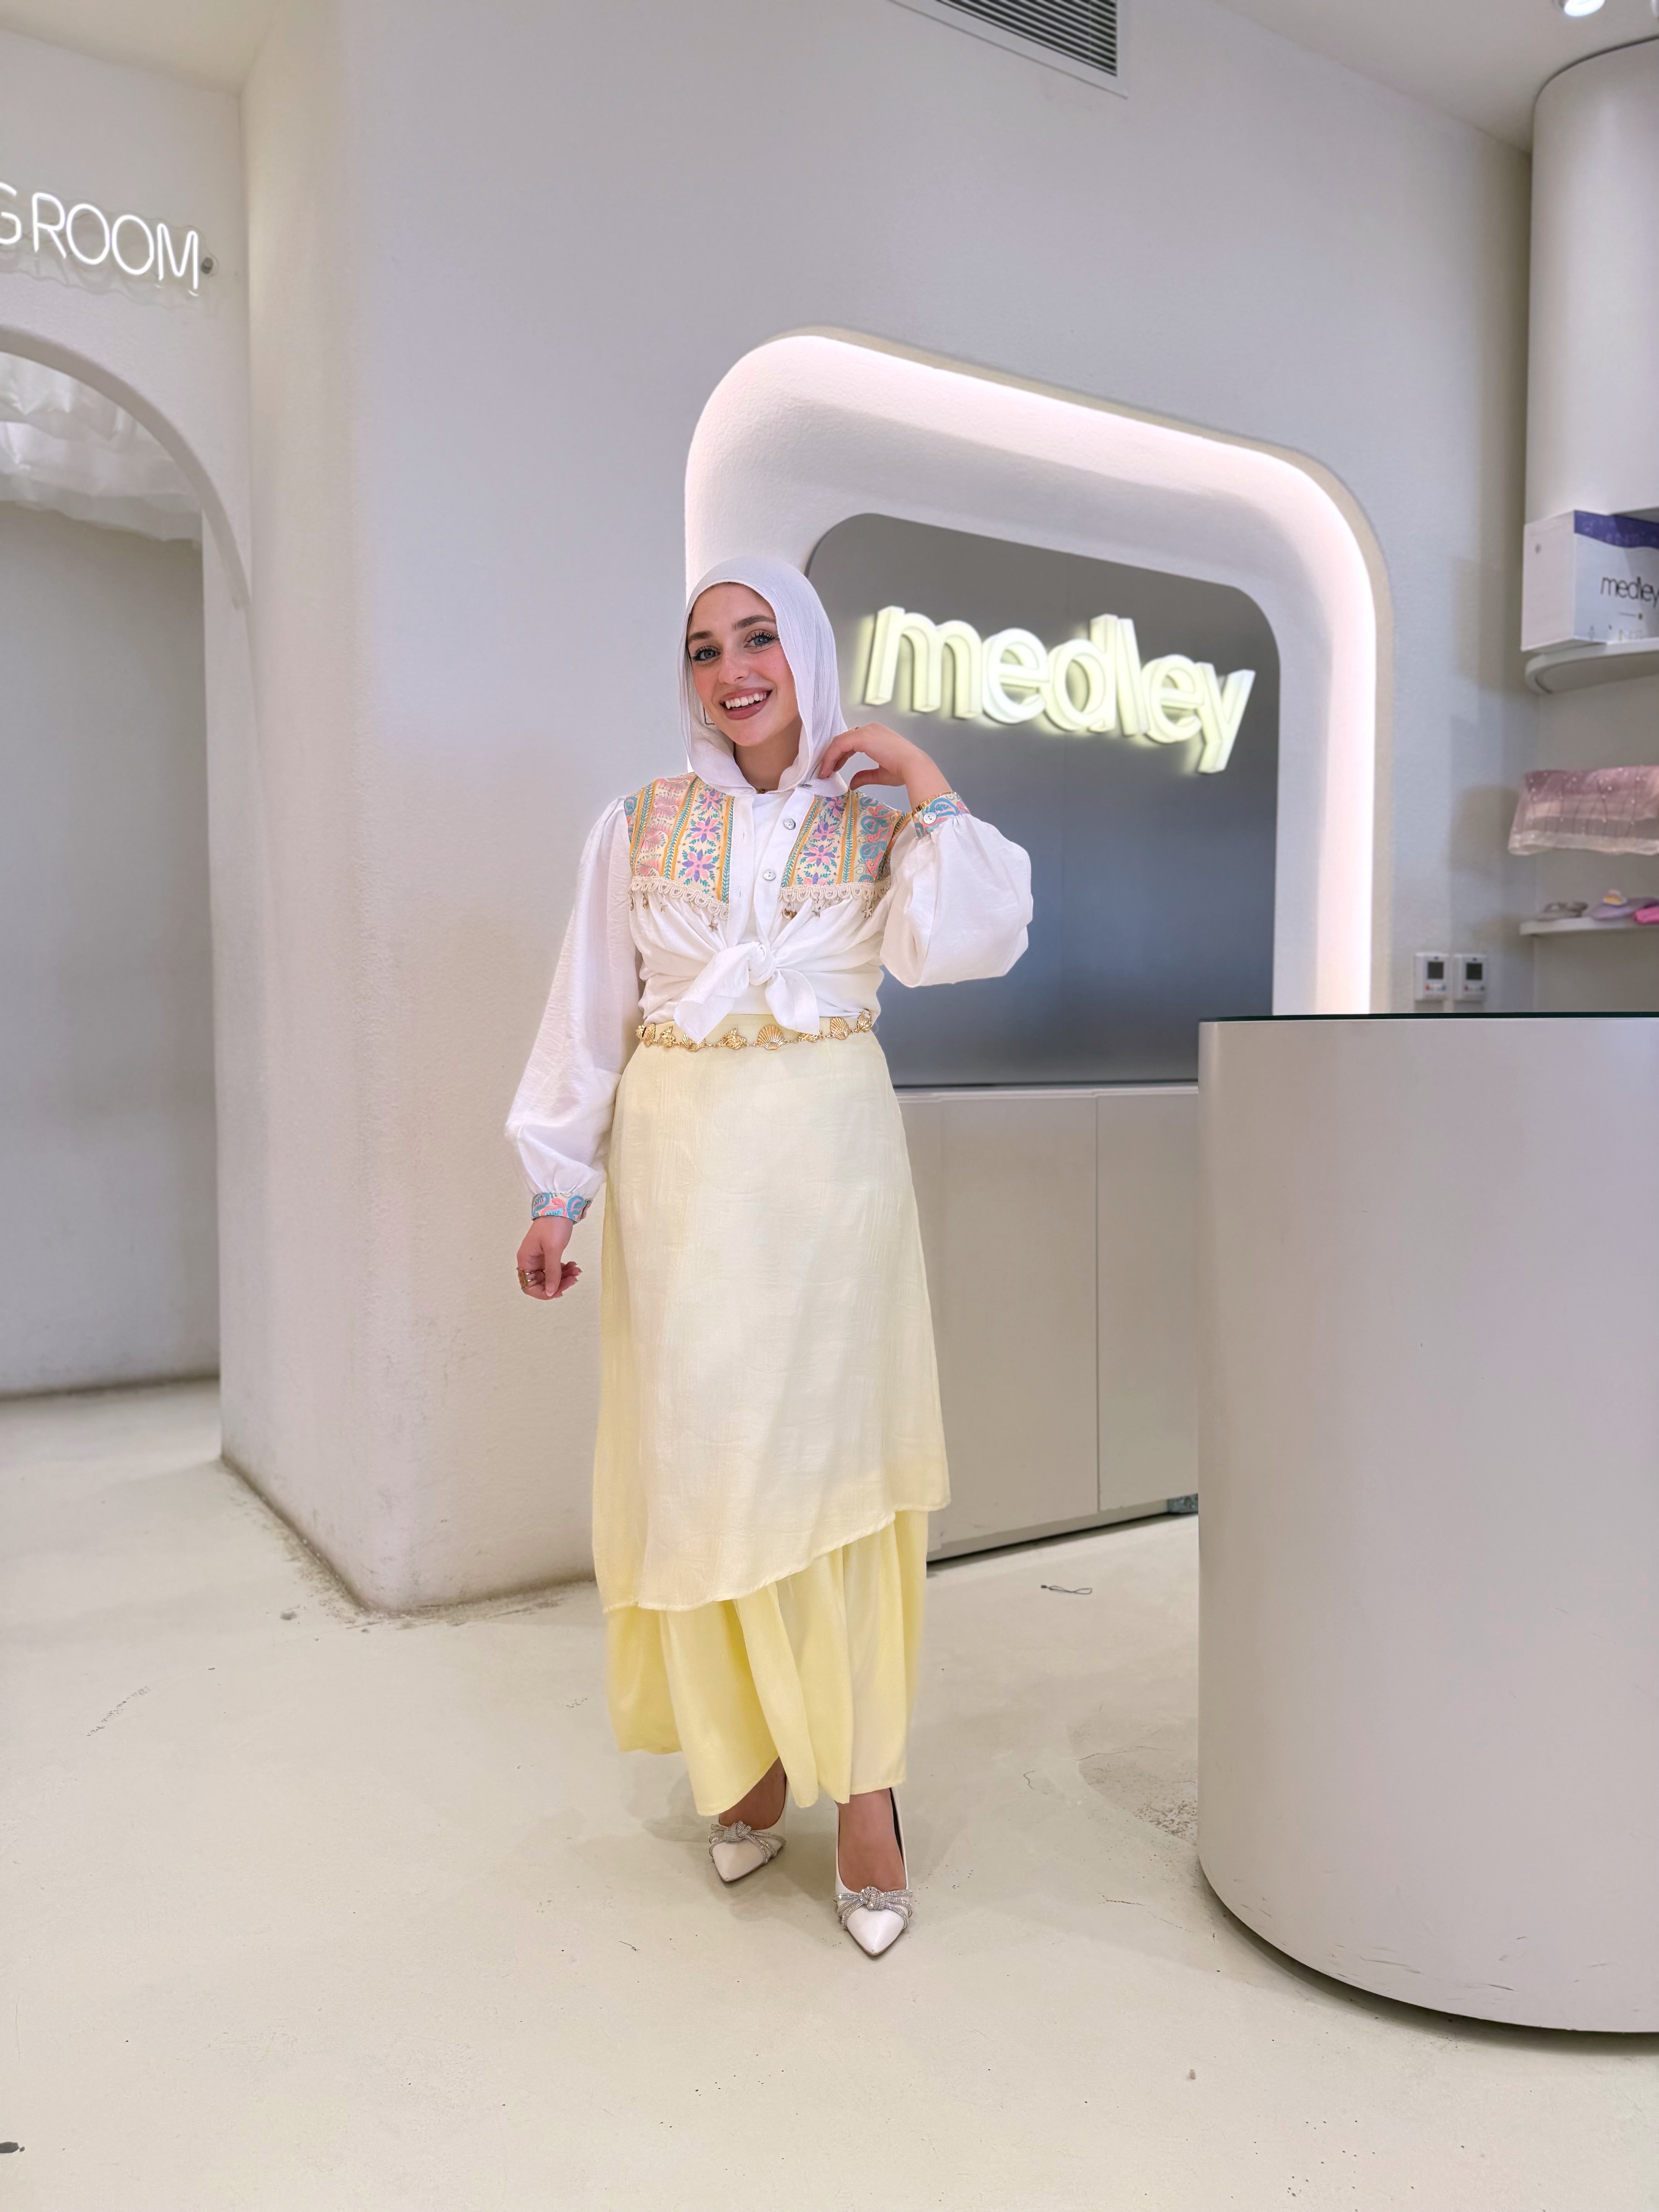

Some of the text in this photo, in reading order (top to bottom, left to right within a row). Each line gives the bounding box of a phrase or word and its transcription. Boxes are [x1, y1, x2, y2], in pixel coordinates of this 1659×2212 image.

[32, 192, 198, 289] ROOM
[1600, 576, 1659, 608] medley
[864, 605, 1256, 774] medley
